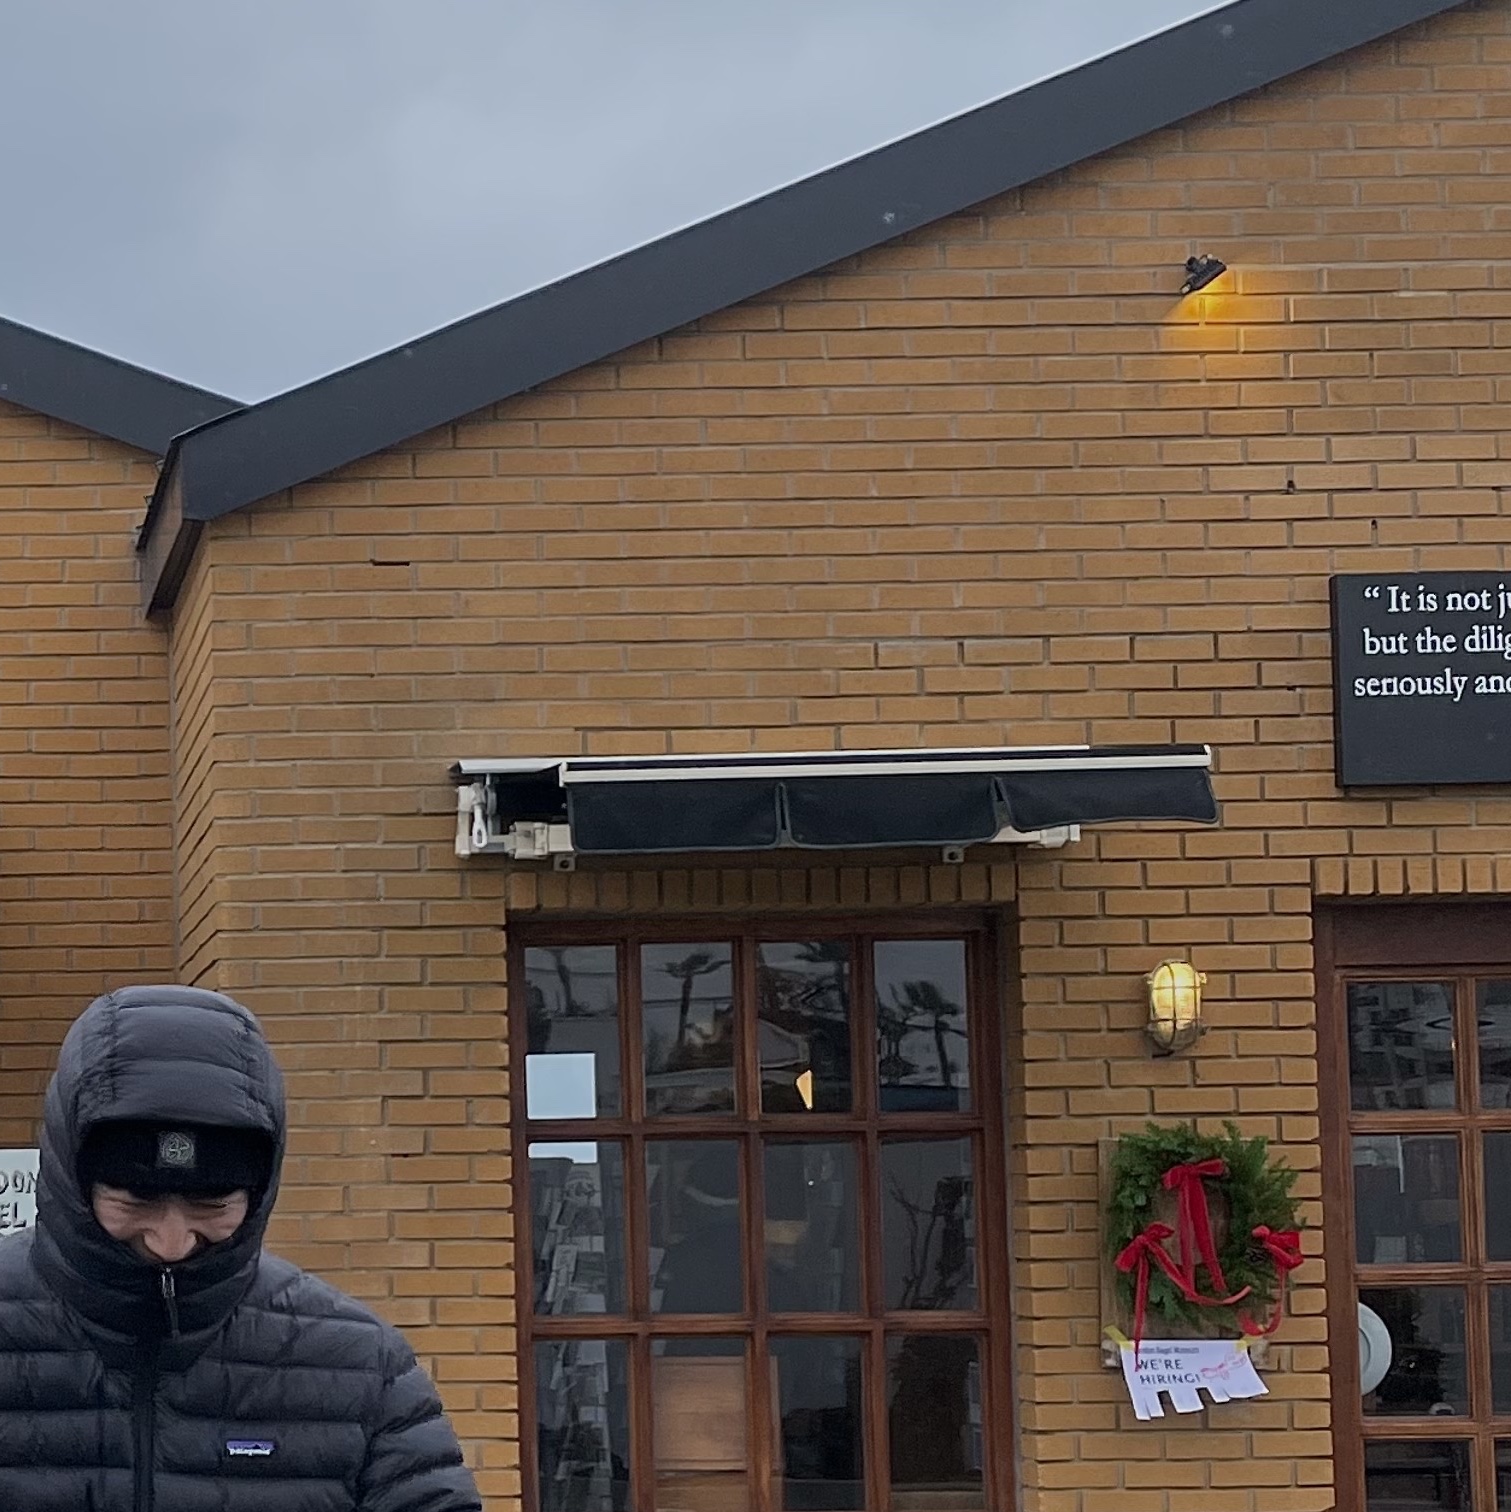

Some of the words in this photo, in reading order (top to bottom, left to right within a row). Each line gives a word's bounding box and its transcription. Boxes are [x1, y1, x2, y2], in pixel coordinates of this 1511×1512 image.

[1418, 584, 1438, 612] is
[1445, 589, 1492, 612] not
[1363, 628, 1409, 654] but
[1415, 626, 1457, 653] the
